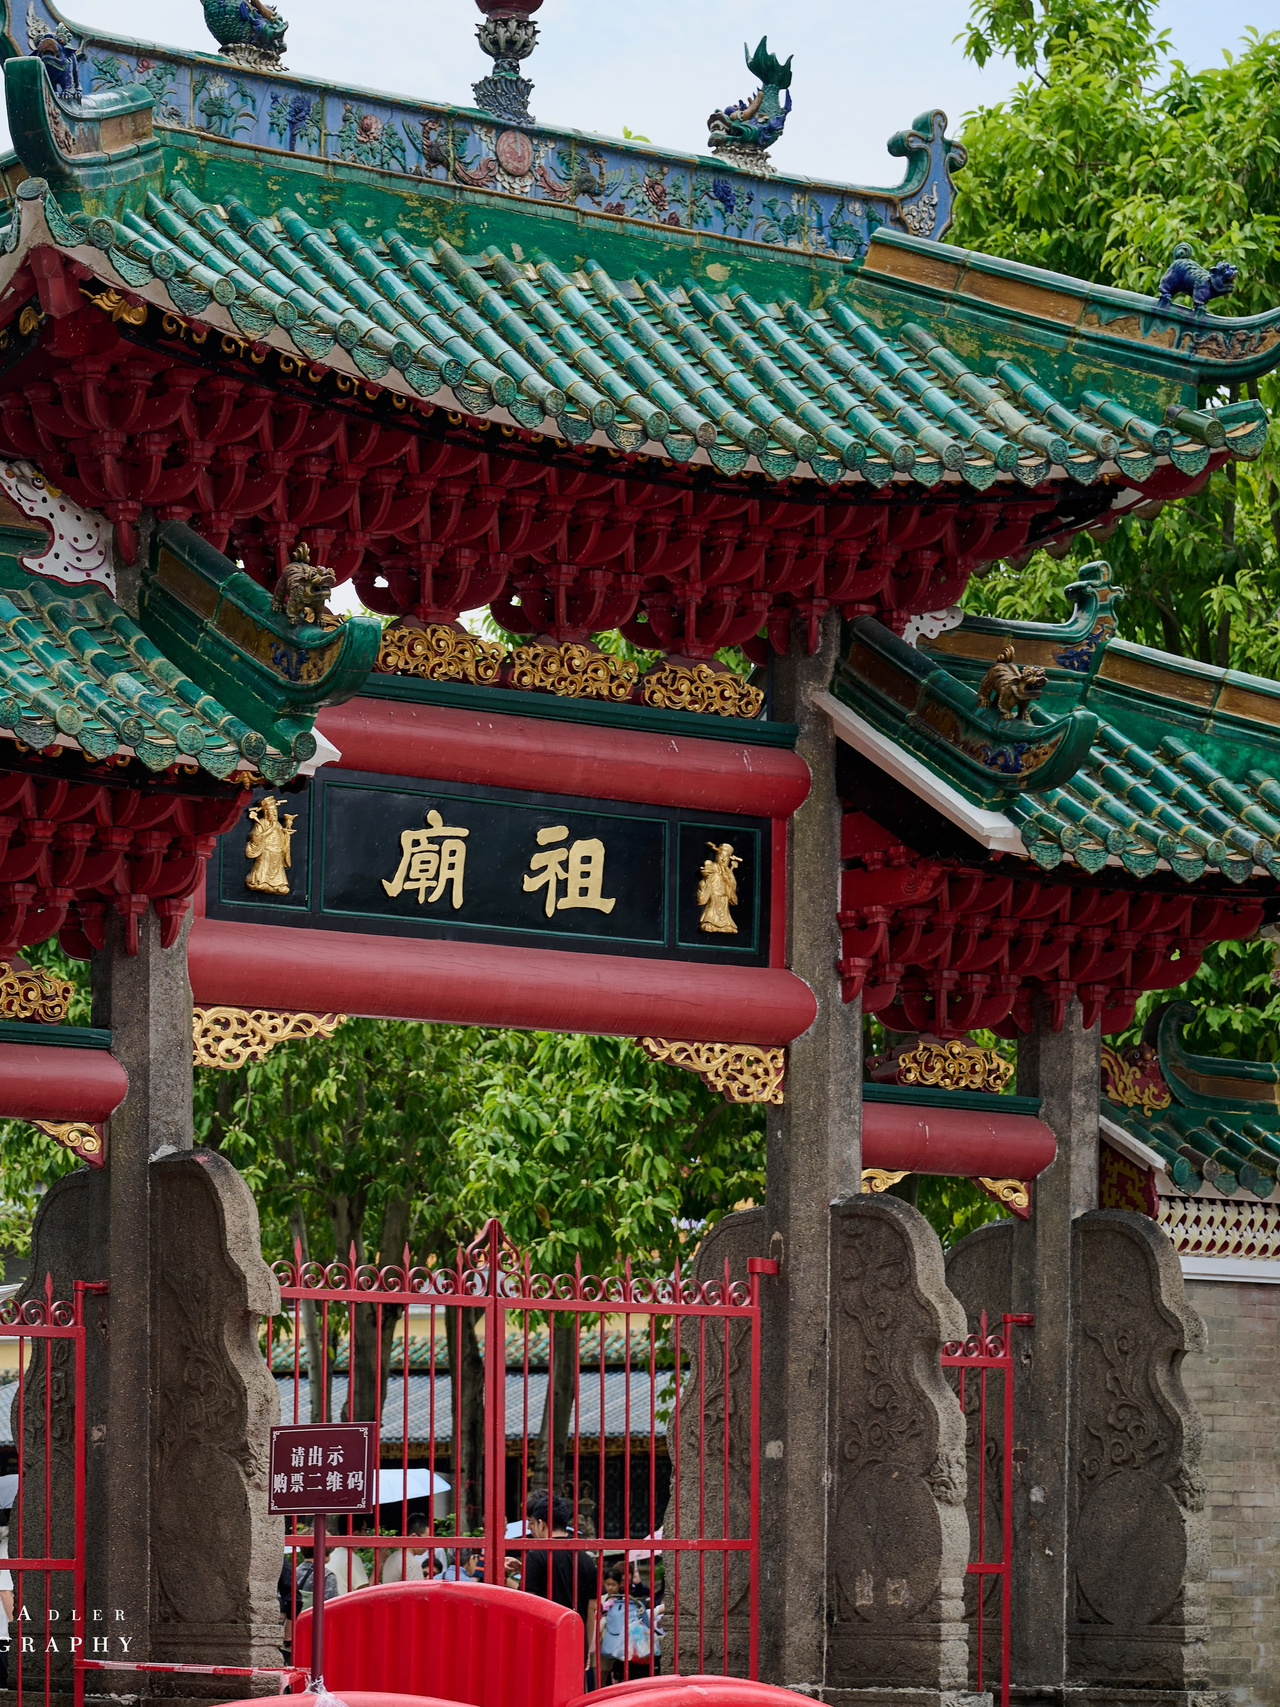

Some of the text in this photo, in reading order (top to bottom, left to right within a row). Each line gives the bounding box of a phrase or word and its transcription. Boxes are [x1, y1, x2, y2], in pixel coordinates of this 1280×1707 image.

[381, 809, 616, 918] 祖廟
[290, 1445, 344, 1467] 请出示
[273, 1470, 364, 1494] 购票二维码
